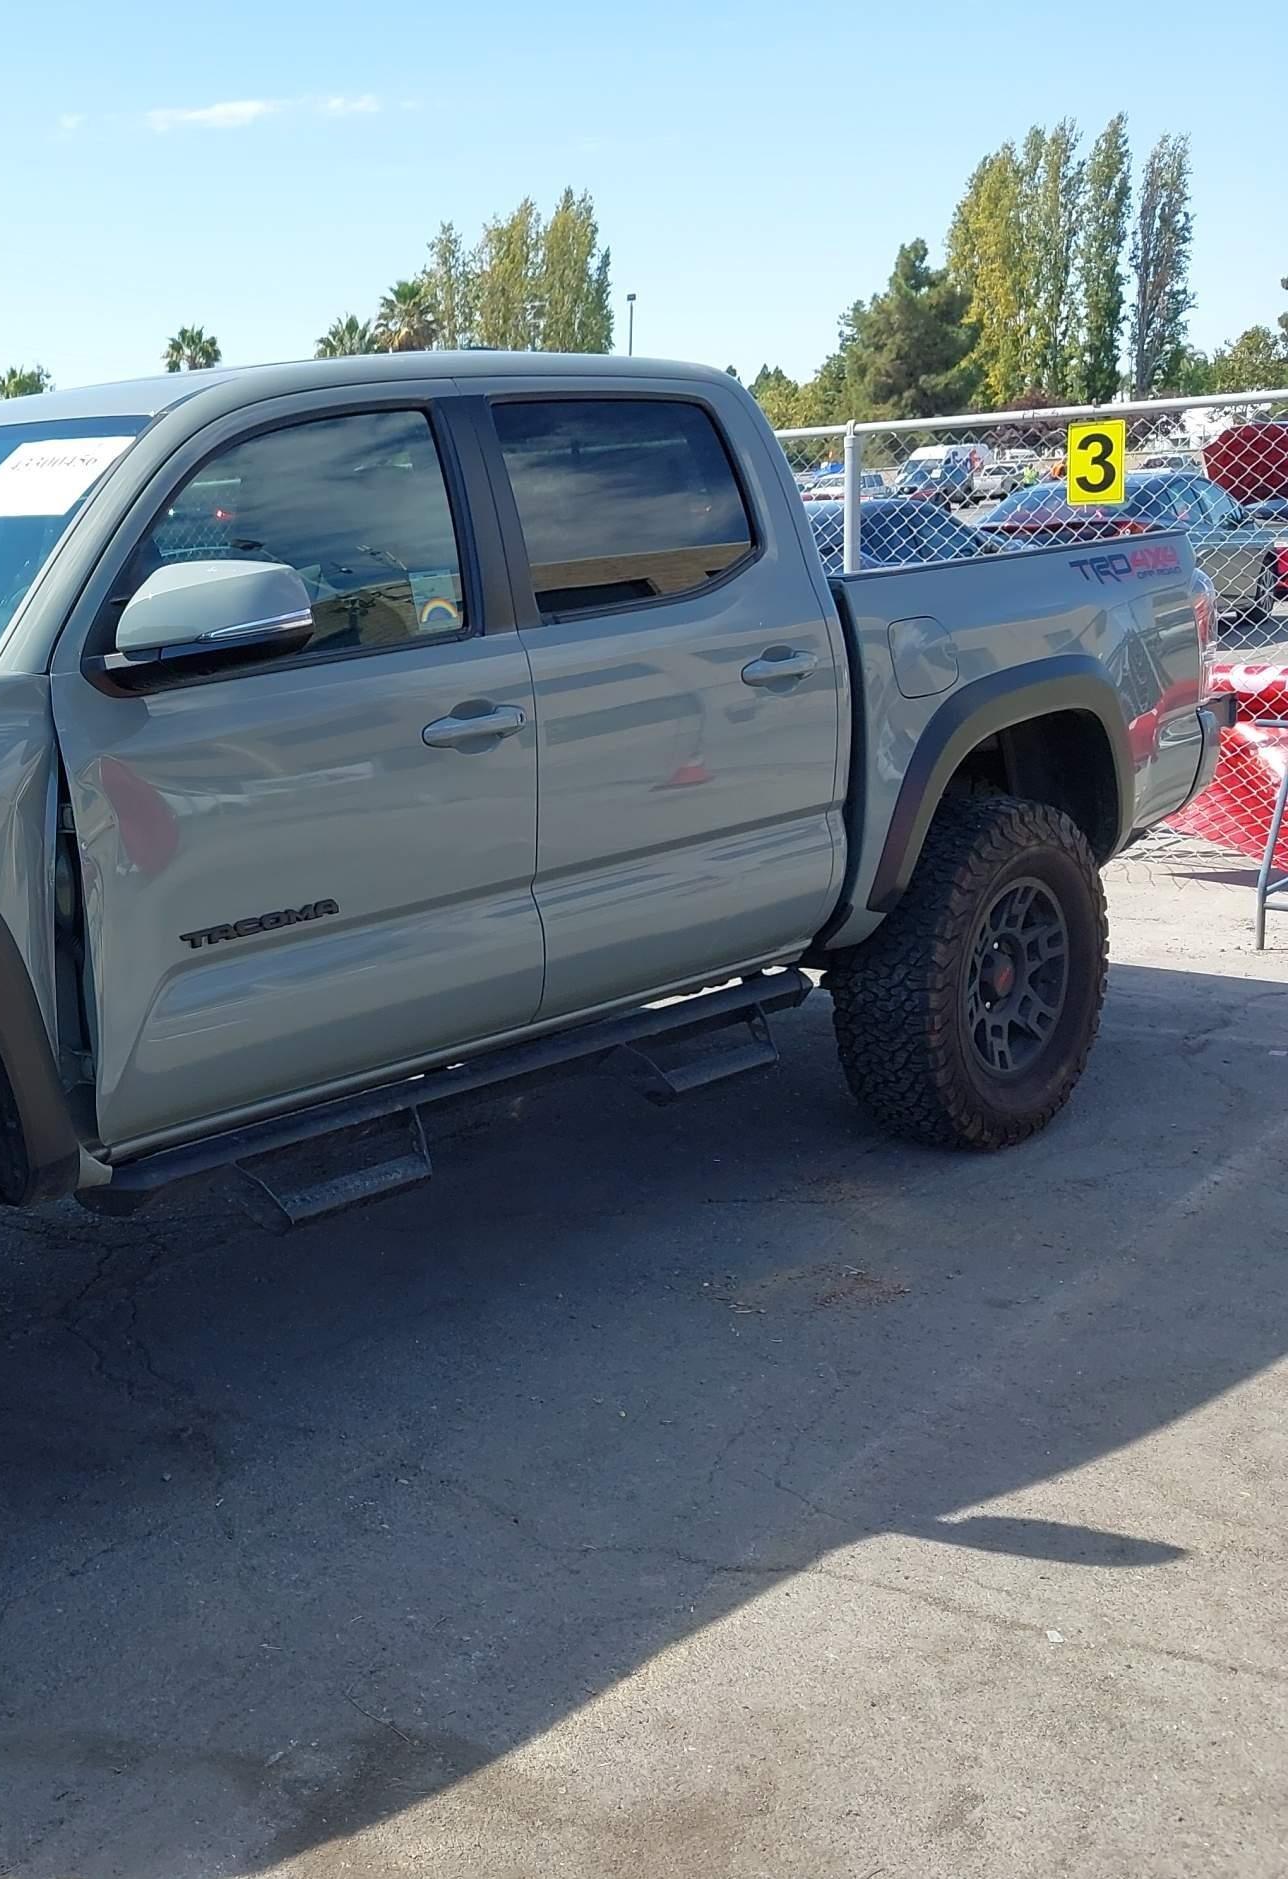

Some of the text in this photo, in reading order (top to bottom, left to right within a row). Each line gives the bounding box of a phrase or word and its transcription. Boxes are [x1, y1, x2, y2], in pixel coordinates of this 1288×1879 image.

[1075, 433, 1116, 493] 3
[1068, 554, 1132, 584] TRD
[179, 898, 340, 949] TACOMA
